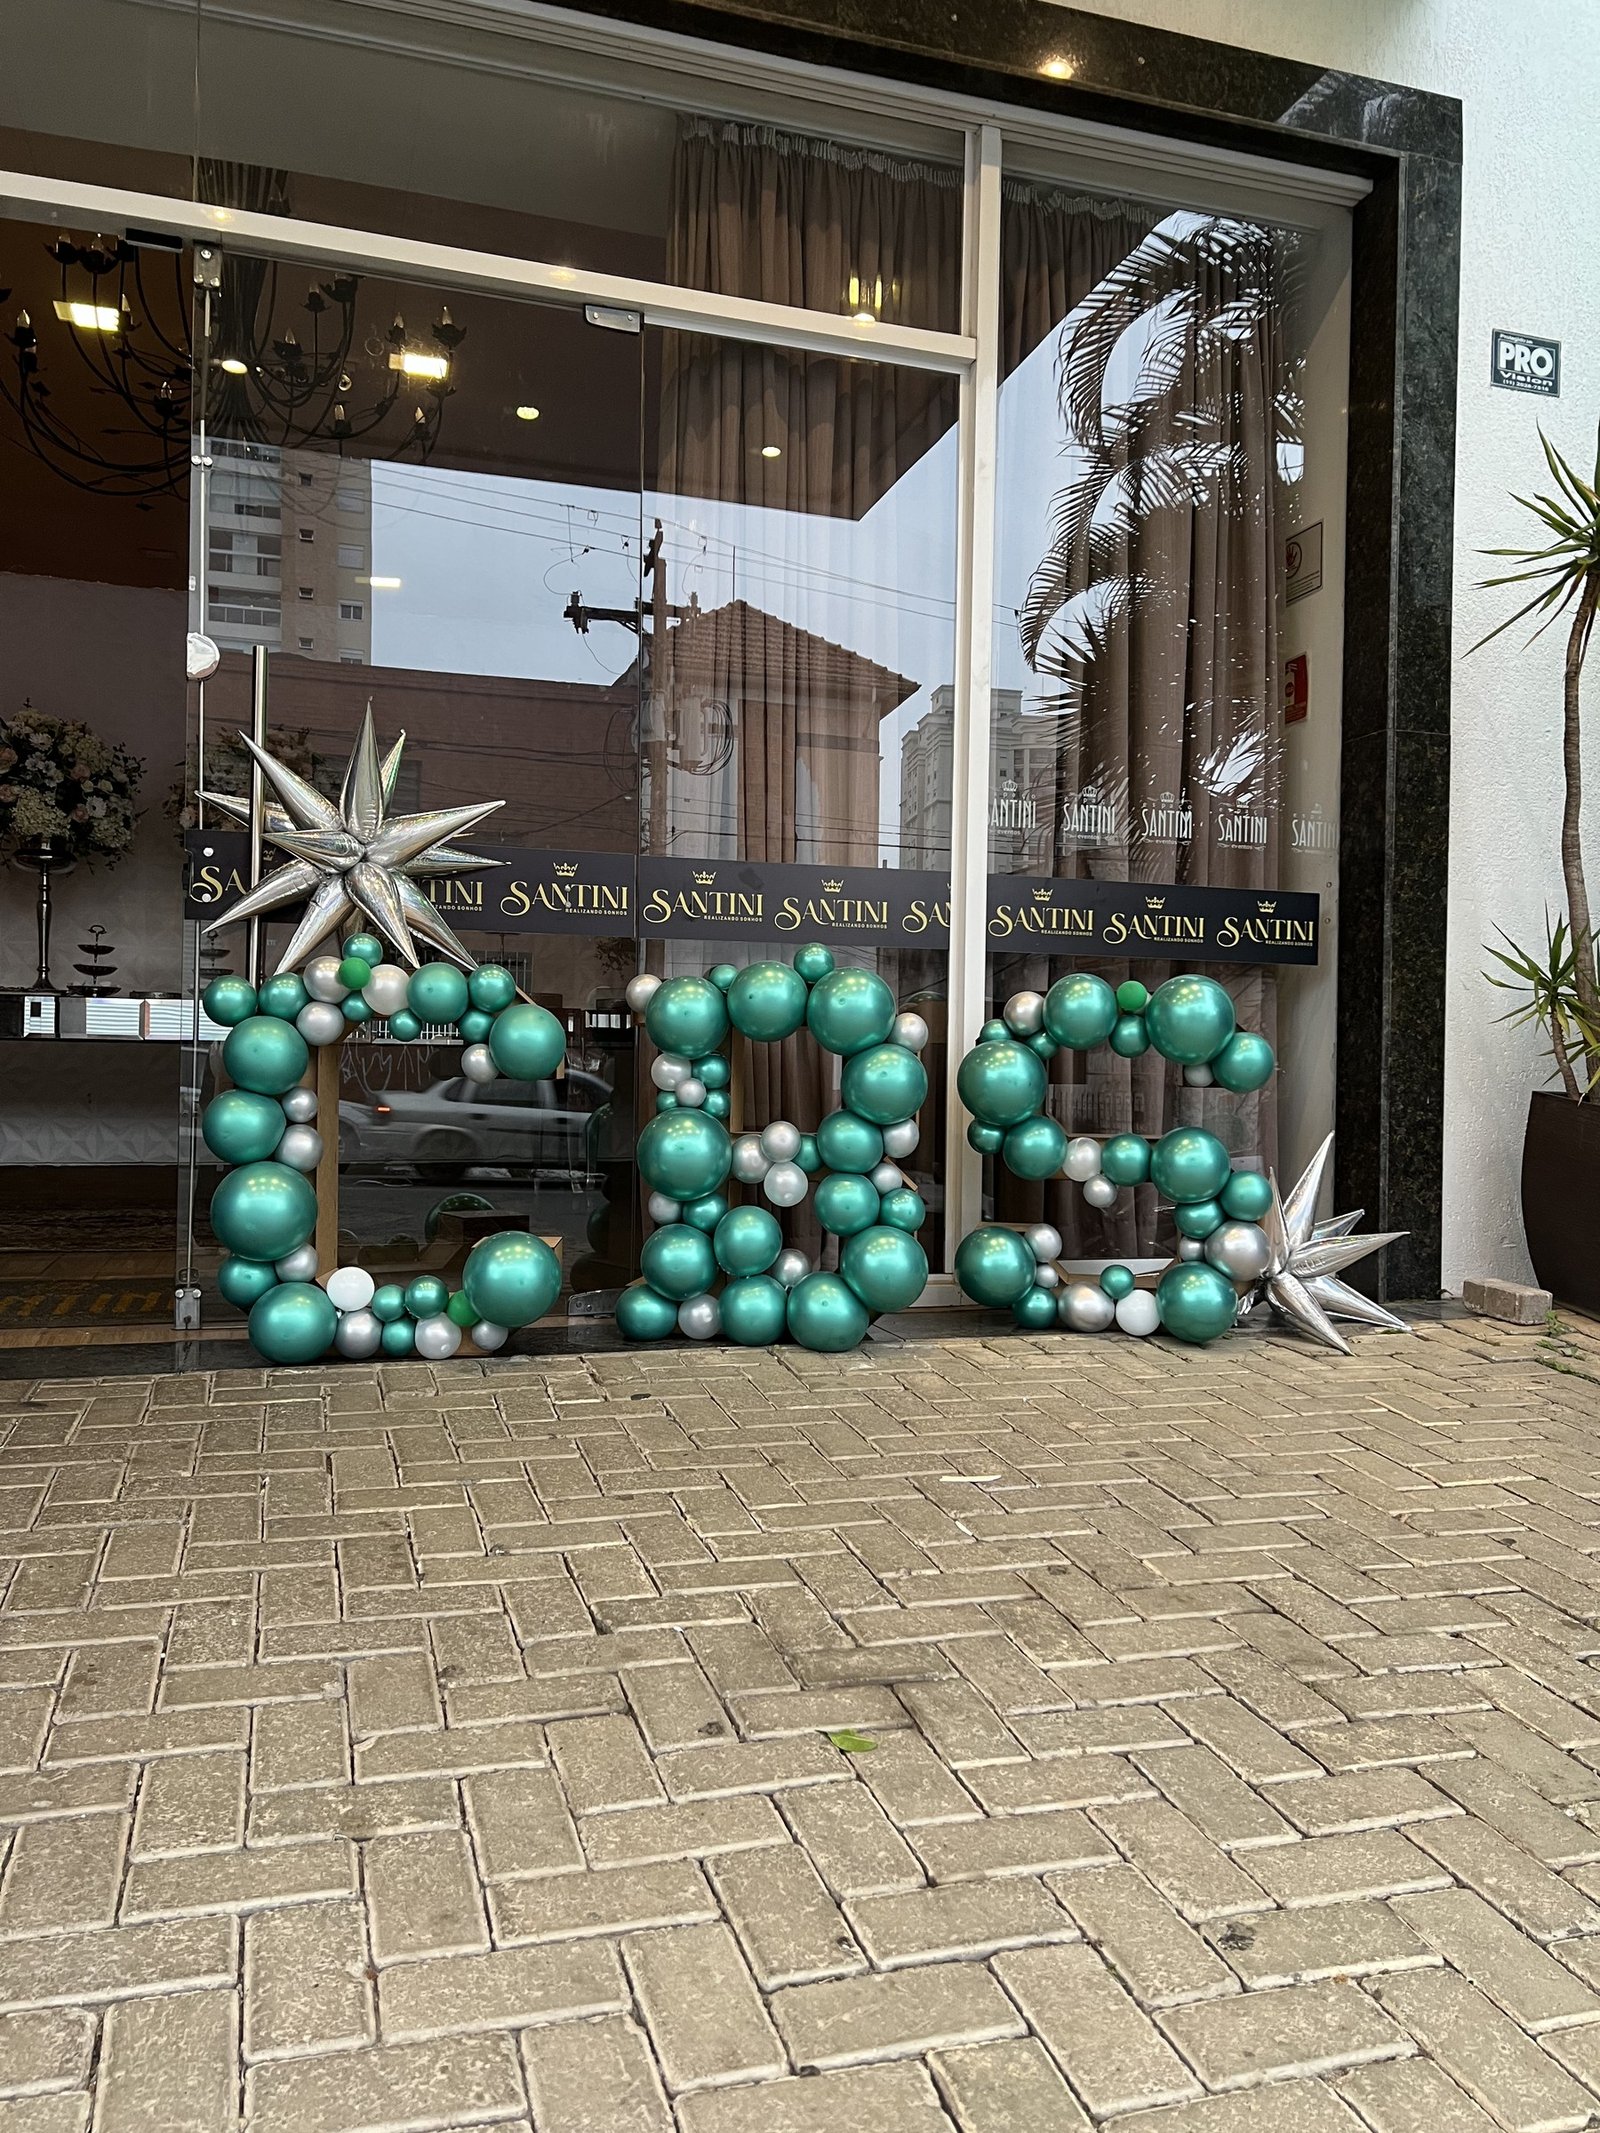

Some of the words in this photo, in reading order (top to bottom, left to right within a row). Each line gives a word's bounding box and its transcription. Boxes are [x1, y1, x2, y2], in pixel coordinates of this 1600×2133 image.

[1500, 341, 1553, 376] PRO
[1063, 803, 1115, 834] SANTINI
[1141, 808, 1193, 839] SANTINI
[1217, 813, 1268, 844] SANTINI
[500, 881, 628, 916] SANTINI
[643, 889, 763, 923] SANTINI
[774, 897, 888, 931] SANTINI
[988, 905, 1094, 937] SANTINI
[1103, 912, 1205, 944] SANTINI
[1217, 916, 1314, 947] SANTINI
